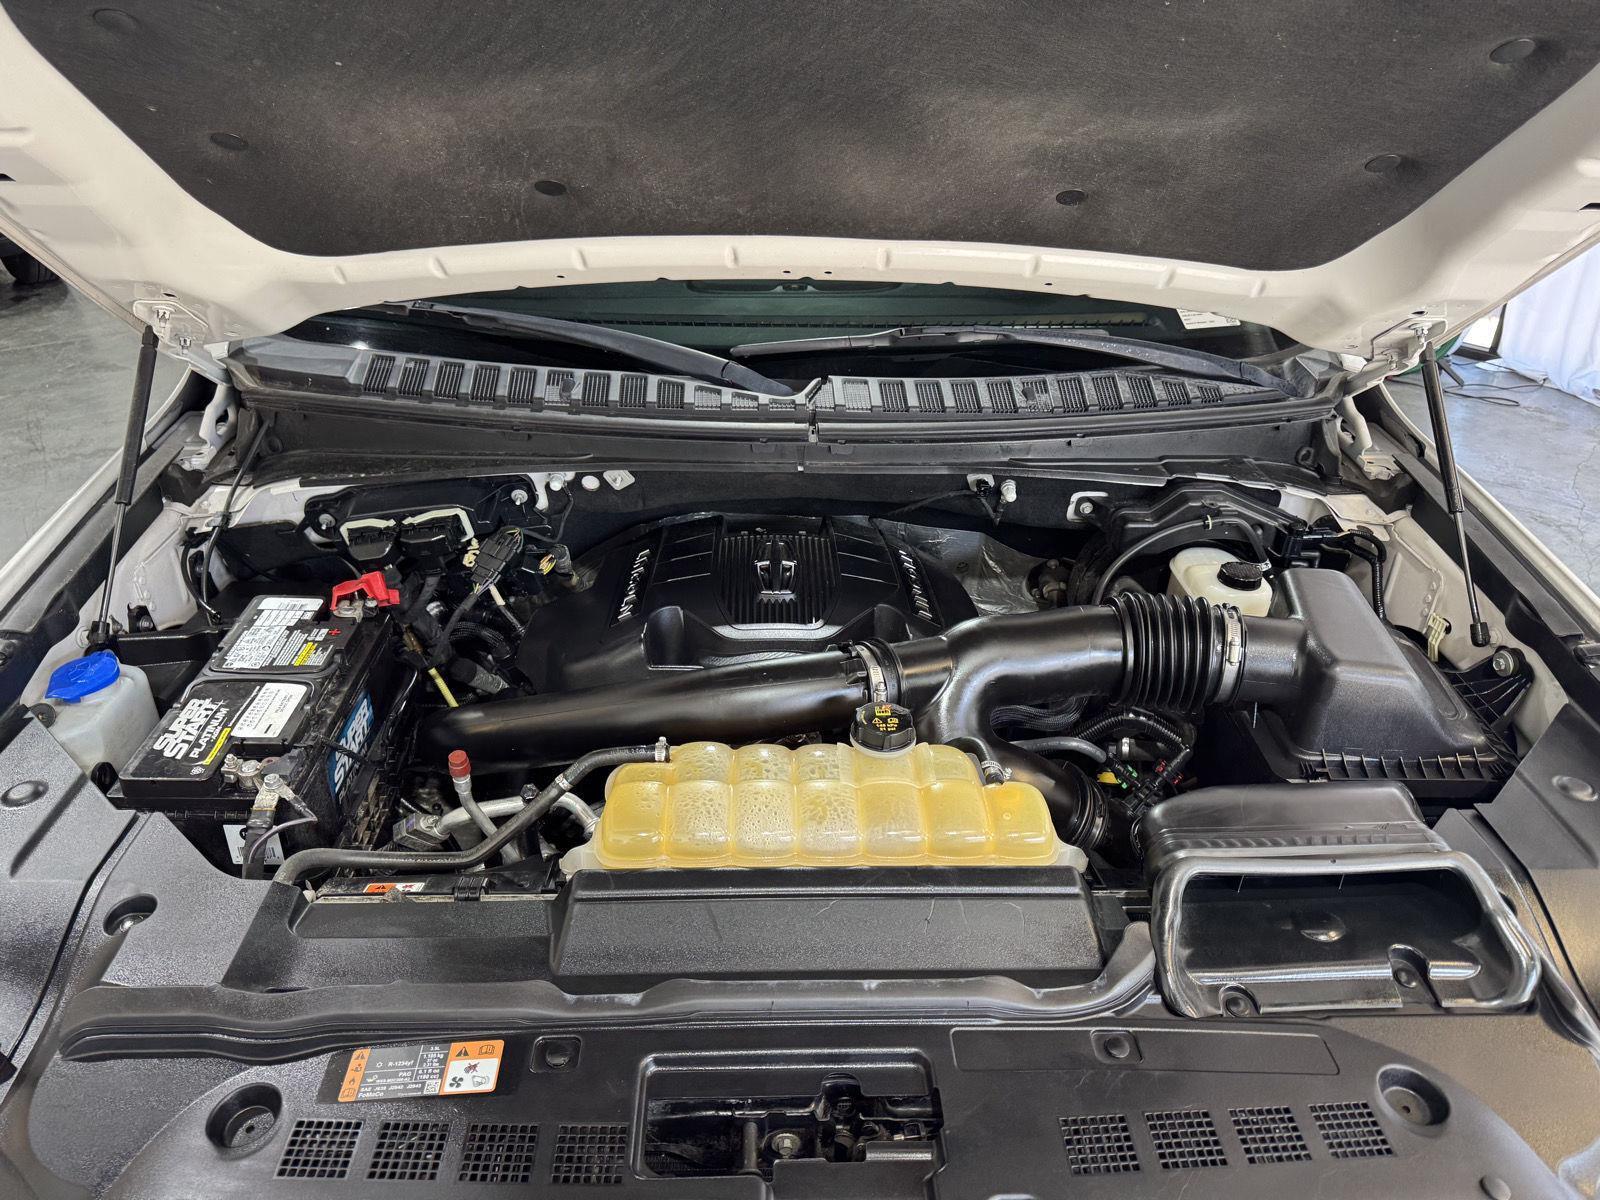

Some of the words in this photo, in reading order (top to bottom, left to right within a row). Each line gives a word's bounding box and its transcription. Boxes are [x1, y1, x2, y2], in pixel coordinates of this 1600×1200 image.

[617, 549, 650, 622] LINCOLN
[153, 698, 212, 751] SUPER
[163, 703, 220, 760] START
[188, 707, 230, 758] PLATINUM
